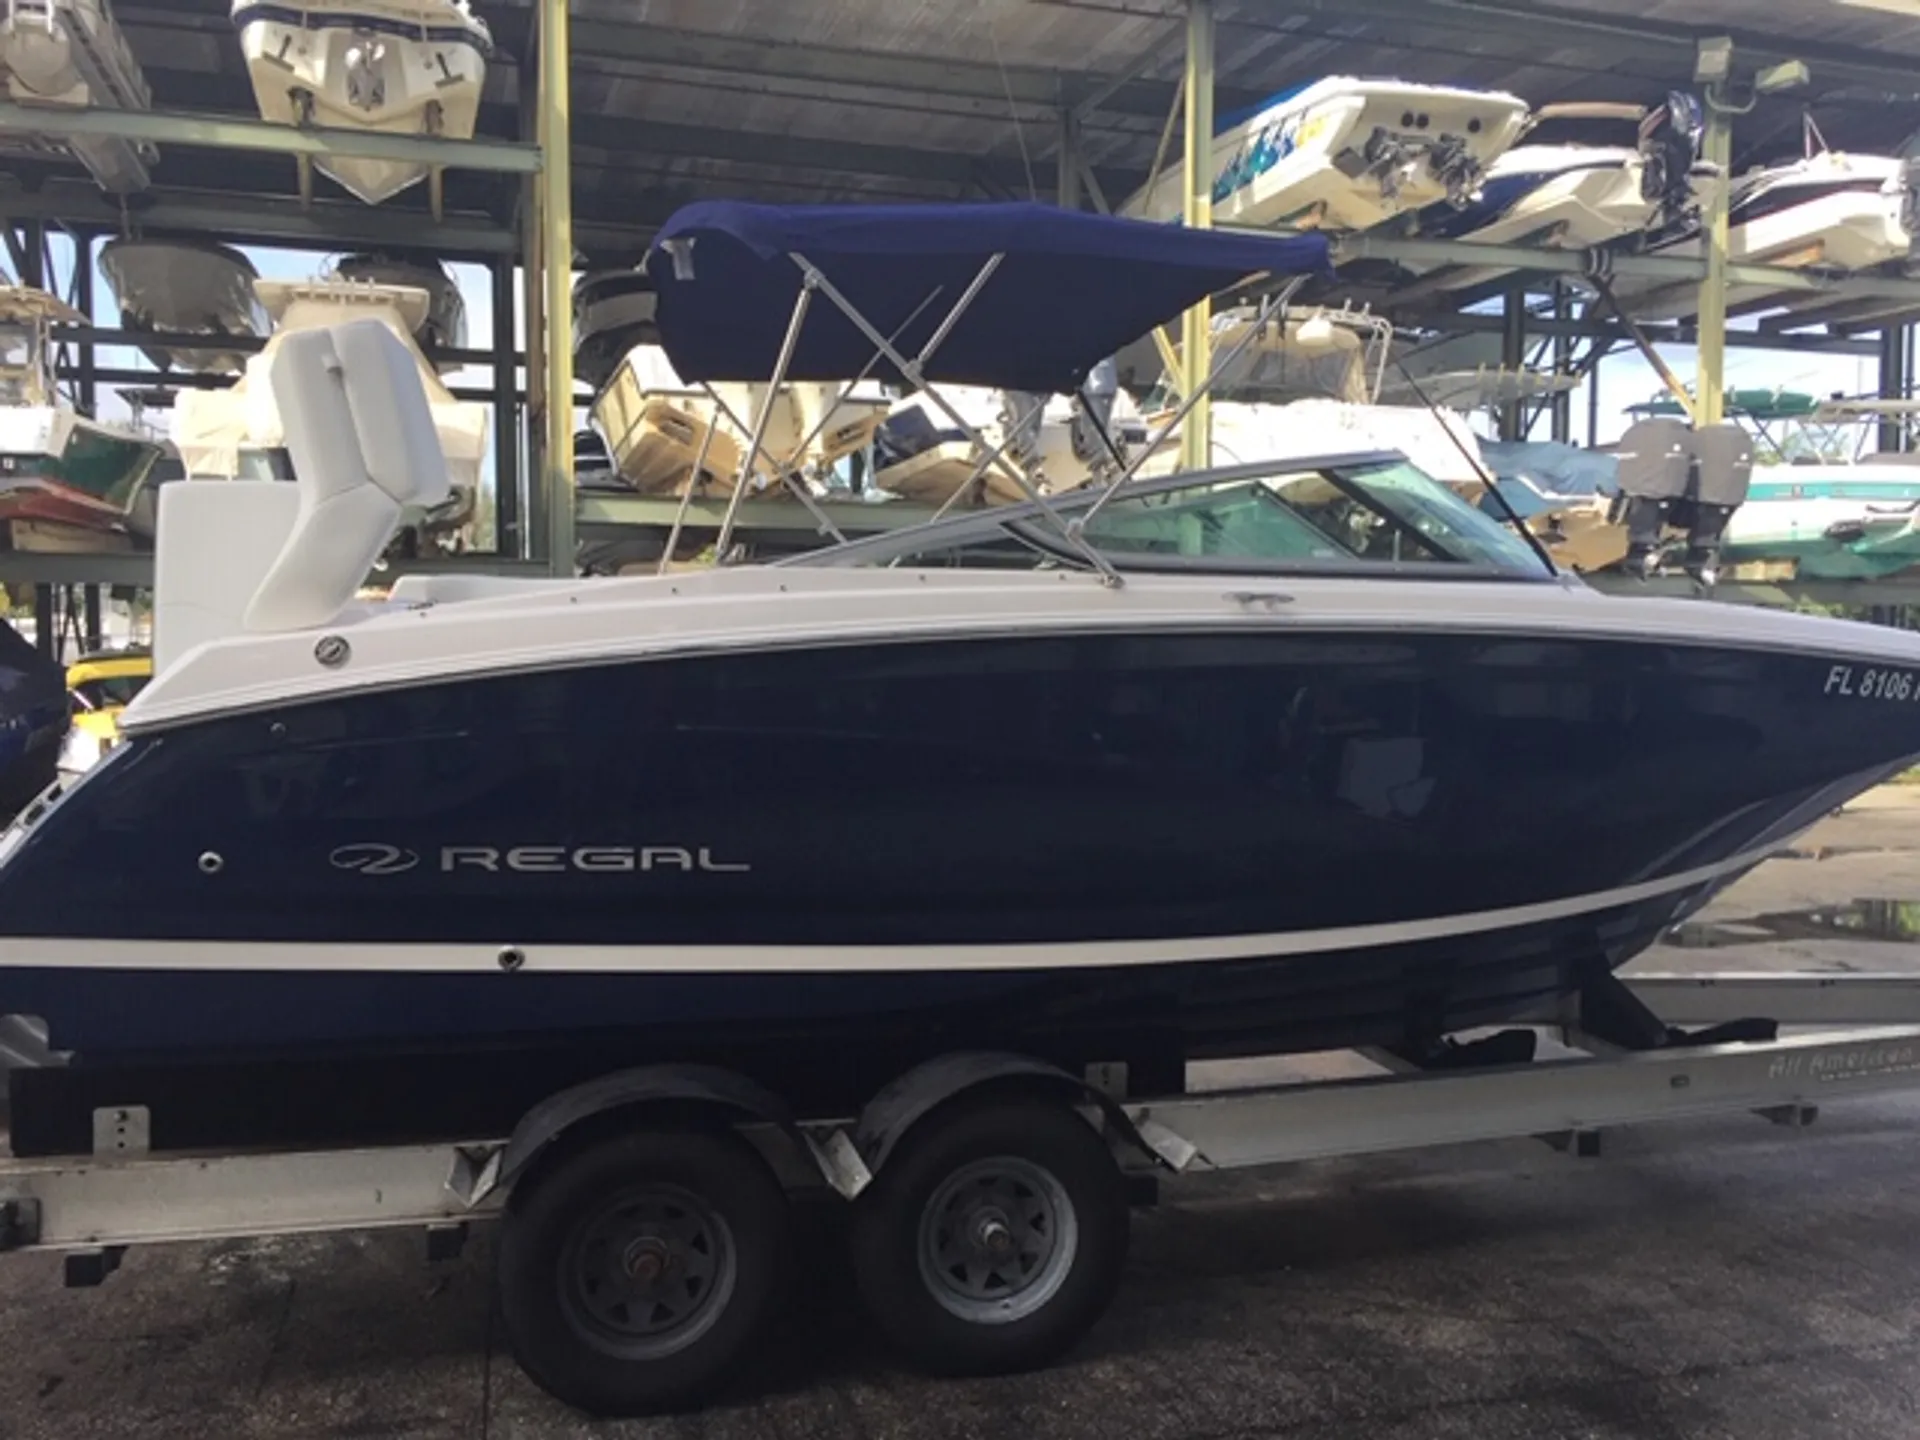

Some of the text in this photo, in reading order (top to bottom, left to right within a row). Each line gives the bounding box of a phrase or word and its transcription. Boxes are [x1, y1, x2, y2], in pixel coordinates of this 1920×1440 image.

[1823, 664, 1853, 695] FL
[1859, 667, 1913, 701] 8106
[440, 846, 752, 872] REGAL
